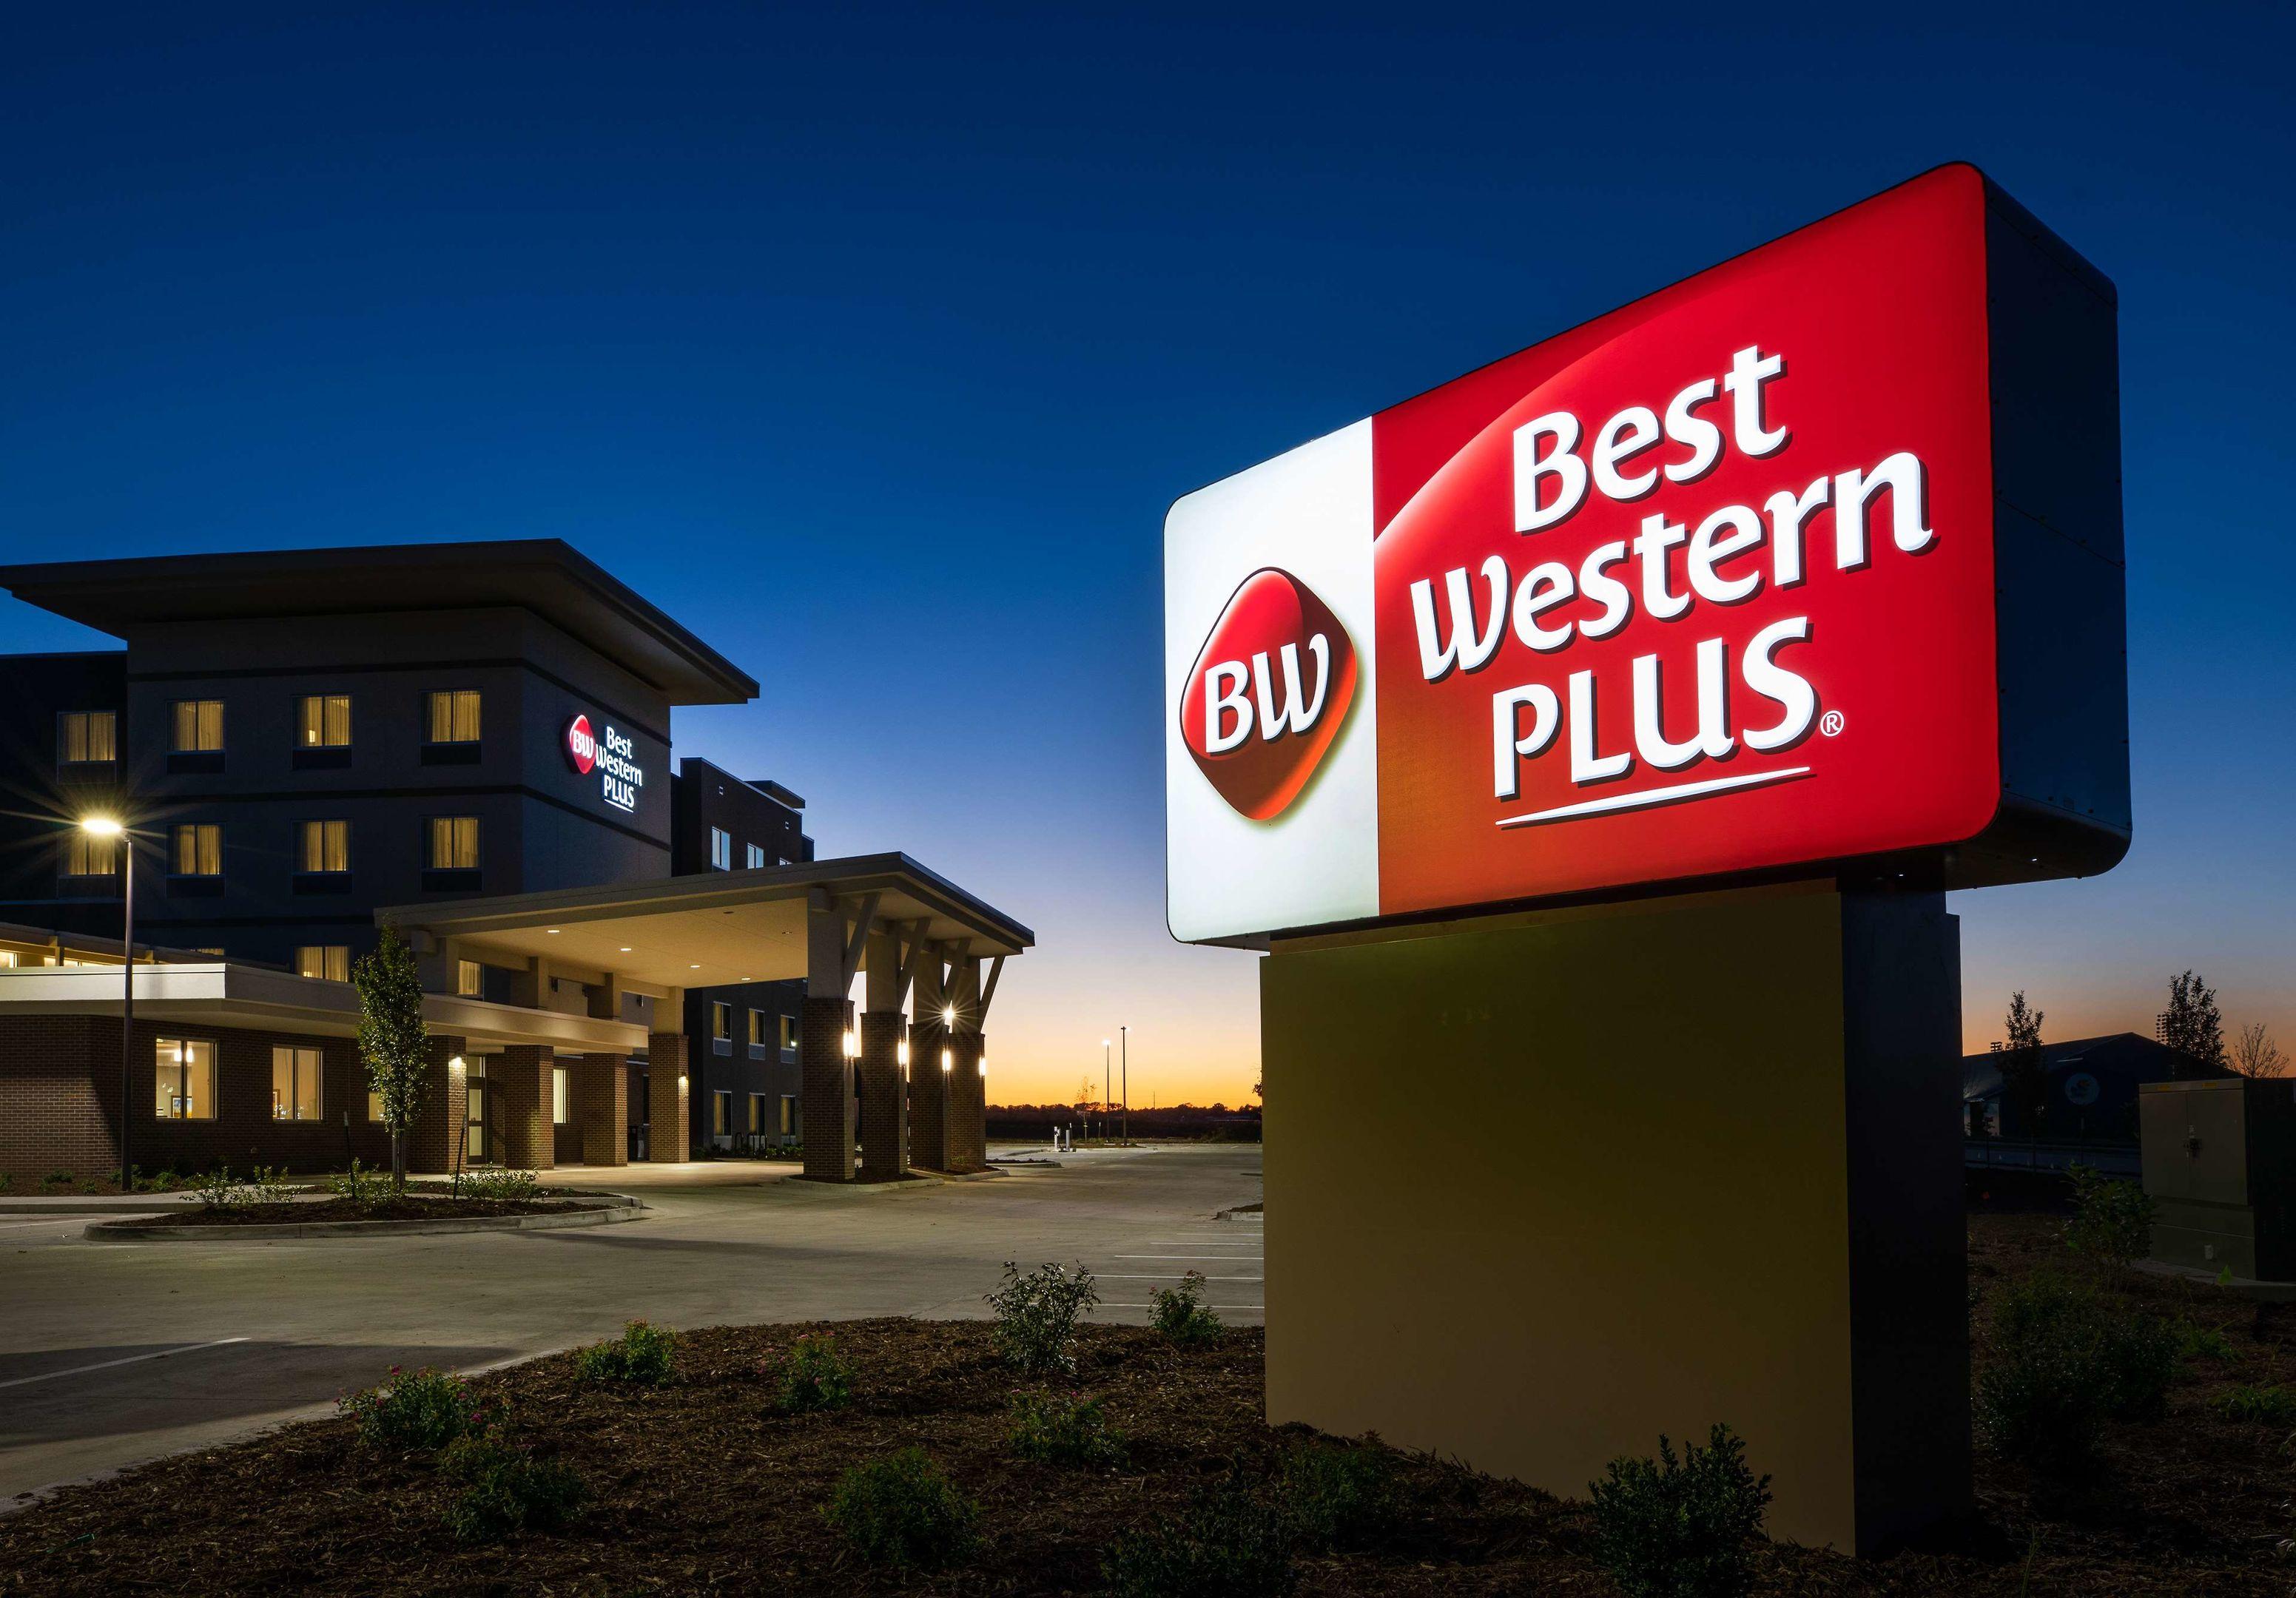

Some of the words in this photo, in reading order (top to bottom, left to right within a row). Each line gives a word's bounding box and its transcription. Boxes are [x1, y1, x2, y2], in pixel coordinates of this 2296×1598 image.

[1512, 345, 1786, 533] Best
[1410, 451, 1933, 681] Western
[1204, 633, 1329, 754] BW
[573, 729, 594, 759] BW
[606, 726, 633, 760] Best
[595, 744, 643, 786] Western
[604, 774, 635, 808] PLUS
